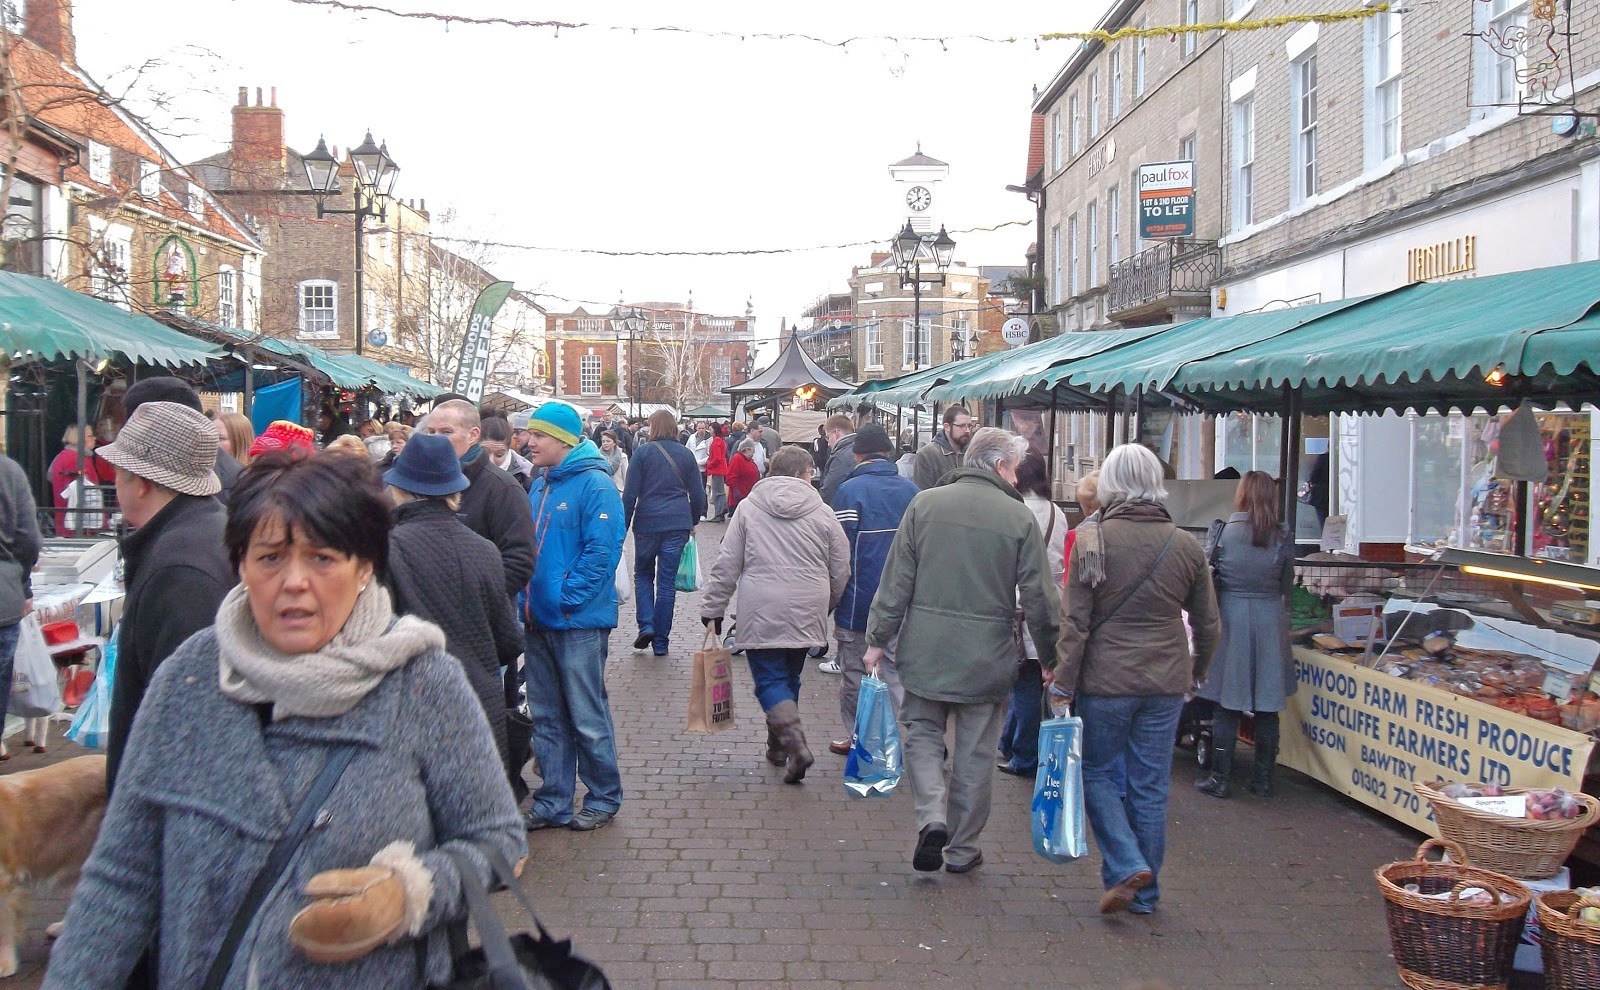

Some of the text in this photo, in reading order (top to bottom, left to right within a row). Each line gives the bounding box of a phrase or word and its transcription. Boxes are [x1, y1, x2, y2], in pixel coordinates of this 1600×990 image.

[1143, 199, 1152, 207] 1ST
[1171, 196, 1189, 204] FLOOR
[1144, 205, 1189, 217] TO LET
[1005, 331, 1028, 339] HSBC
[467, 316, 492, 402] BEER
[455, 367, 470, 396] TOM
[1311, 695, 1511, 787] SUTCLIFFE FARMERS LTD
[1364, 682, 1408, 718] FARM
[1415, 699, 1469, 740] FRESH
[1478, 719, 1573, 777] PRODUCE
[1361, 745, 1417, 782] BAWTRY
[1352, 768, 1387, 799] 01302
[1393, 787, 1420, 814] 770
